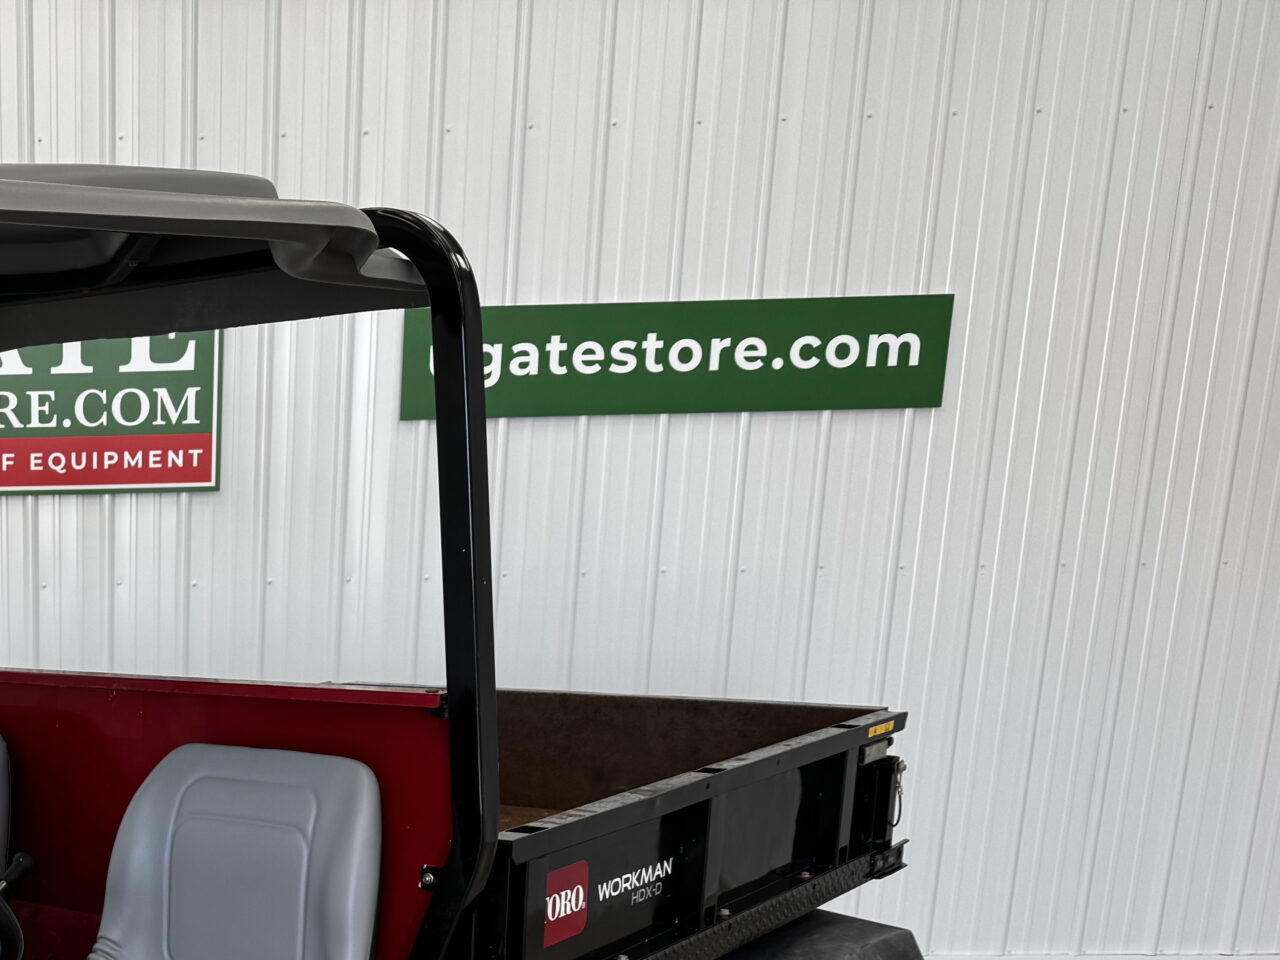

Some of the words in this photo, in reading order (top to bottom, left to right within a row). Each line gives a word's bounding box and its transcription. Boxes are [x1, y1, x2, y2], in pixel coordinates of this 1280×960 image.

[429, 331, 921, 388] gatestore.com
[29, 449, 204, 472] EQUIPMENT
[598, 857, 673, 902] WORKMAN
[631, 882, 663, 905] HDX-D
[546, 885, 585, 921] ORO
